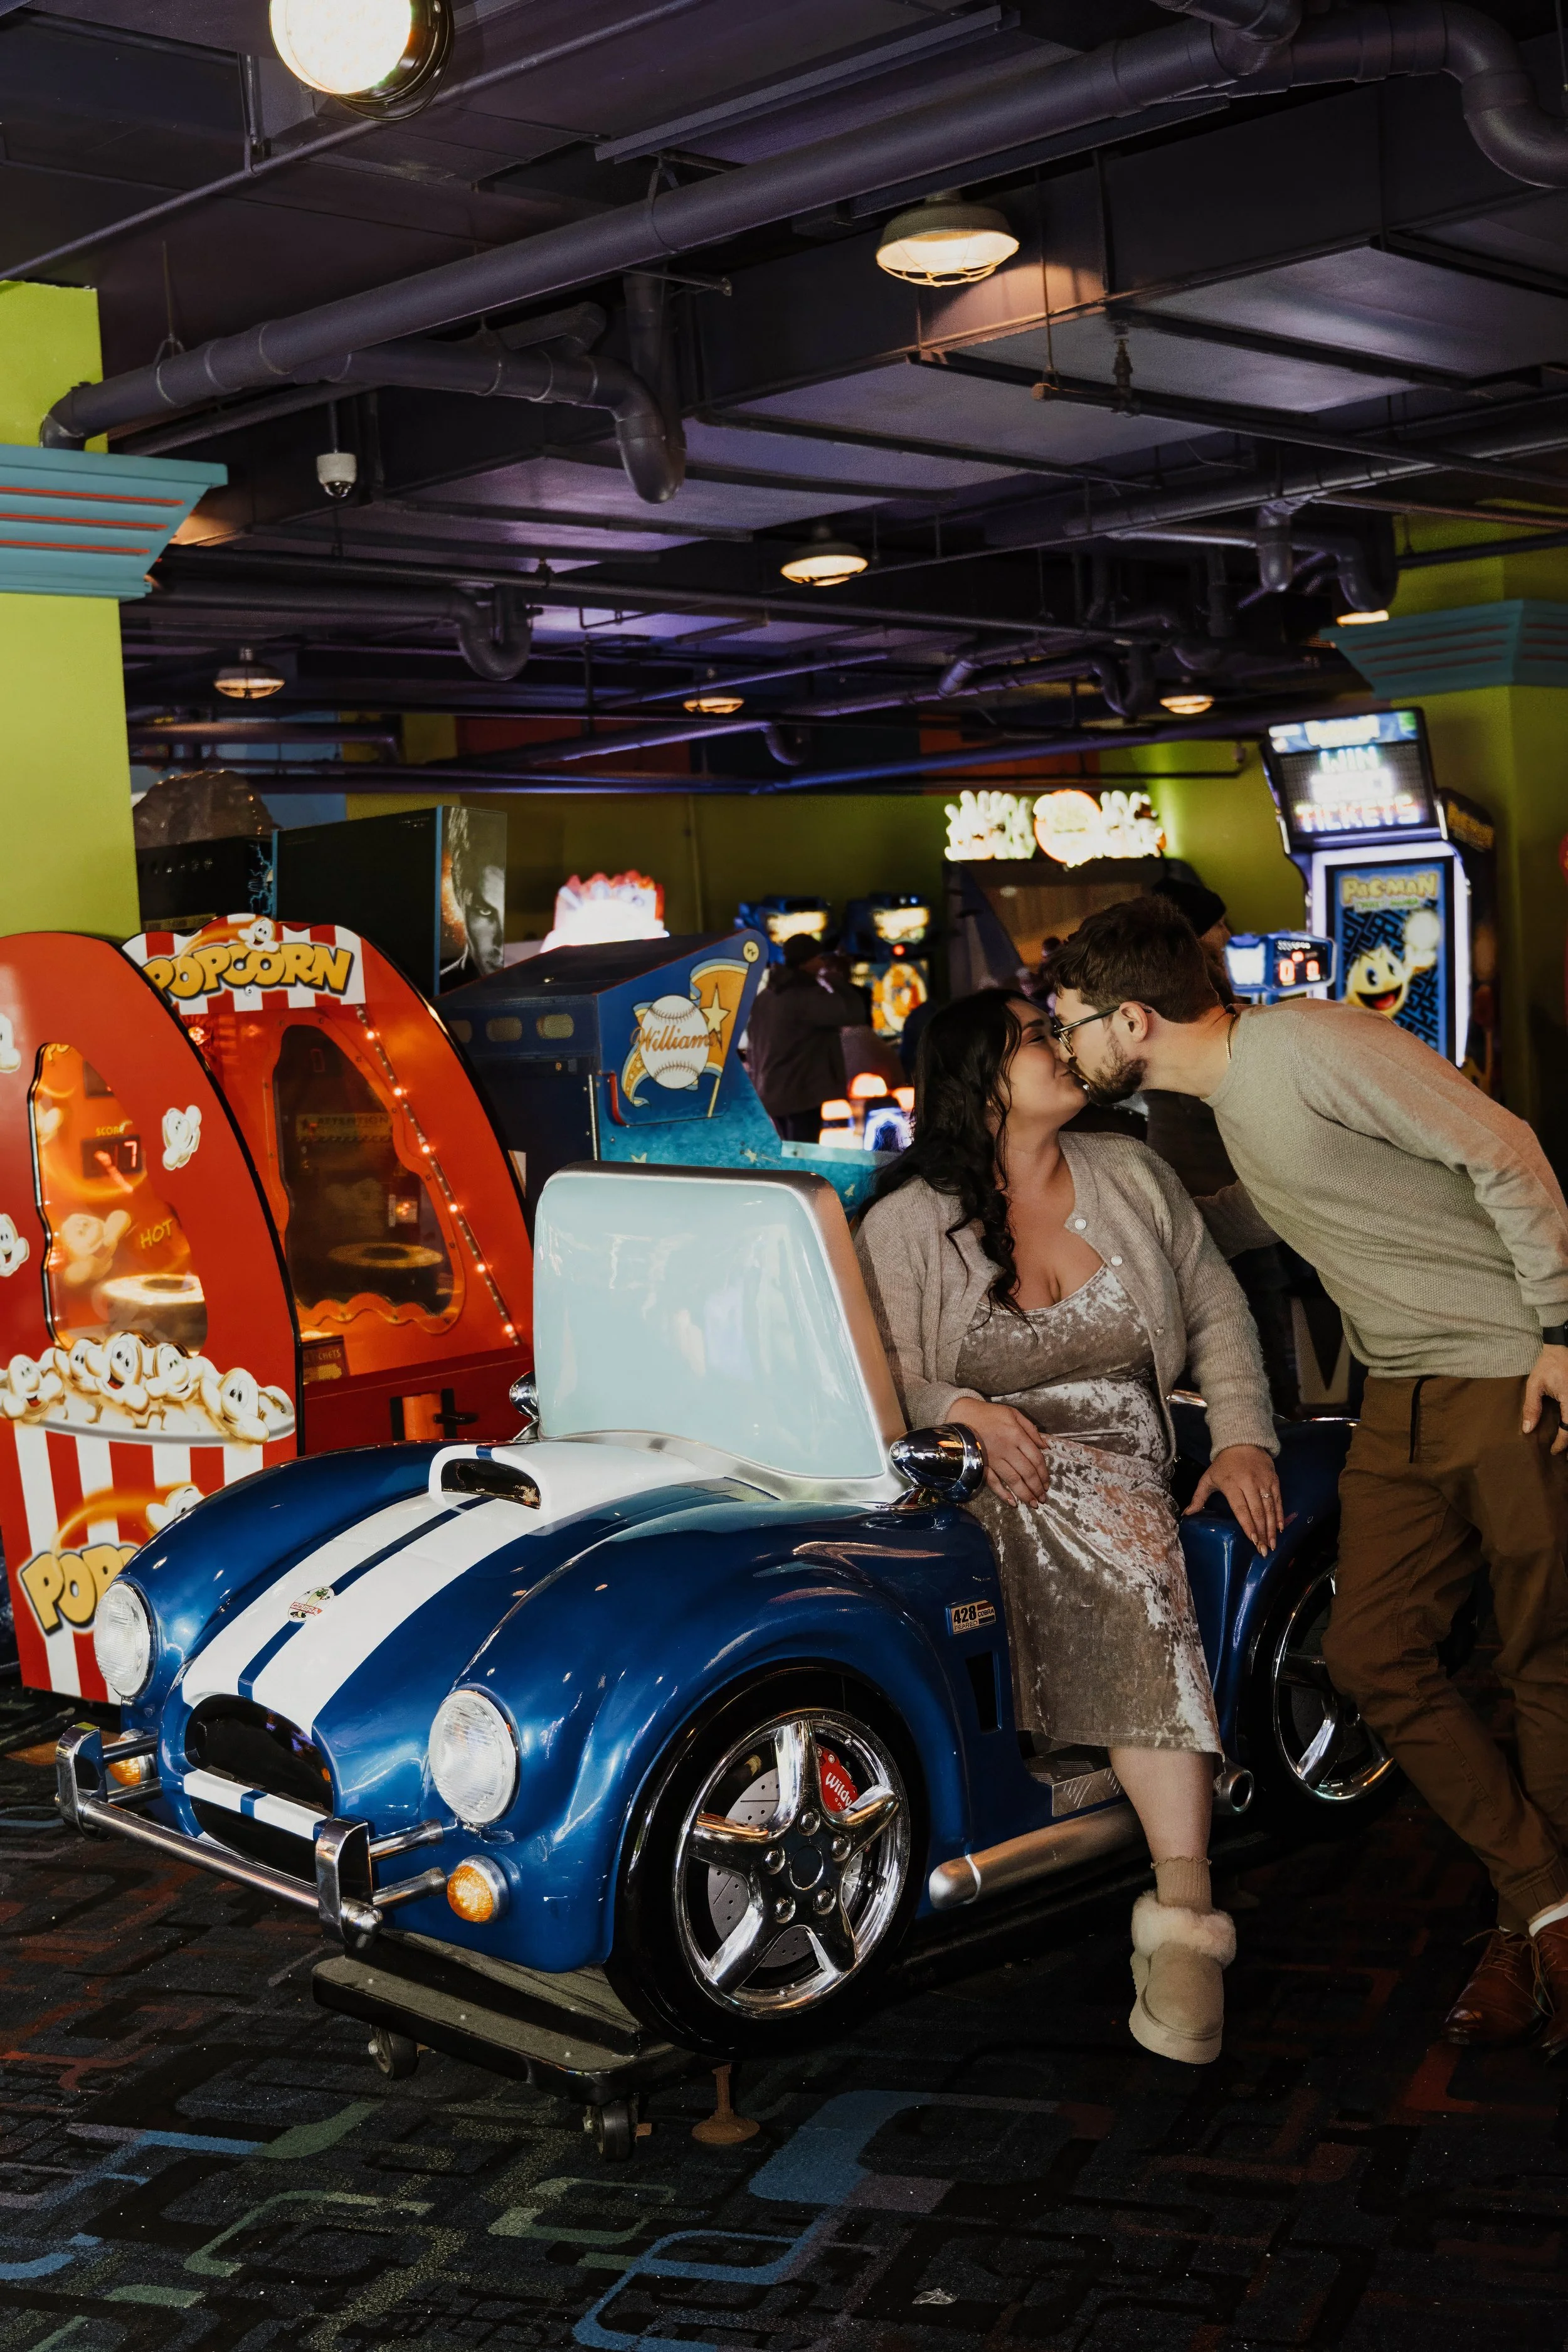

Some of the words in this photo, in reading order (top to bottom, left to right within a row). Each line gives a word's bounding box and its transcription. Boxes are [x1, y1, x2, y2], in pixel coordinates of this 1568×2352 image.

[1320, 745, 1378, 773] WIN
[1295, 795, 1420, 832] TICKETS
[142, 943, 355, 999] POPCORN
[140, 1218, 173, 1249] HOT
[20, 1543, 139, 1637] POP
[953, 1605, 977, 1624] 428
[978, 1608, 994, 1618] COBRA
